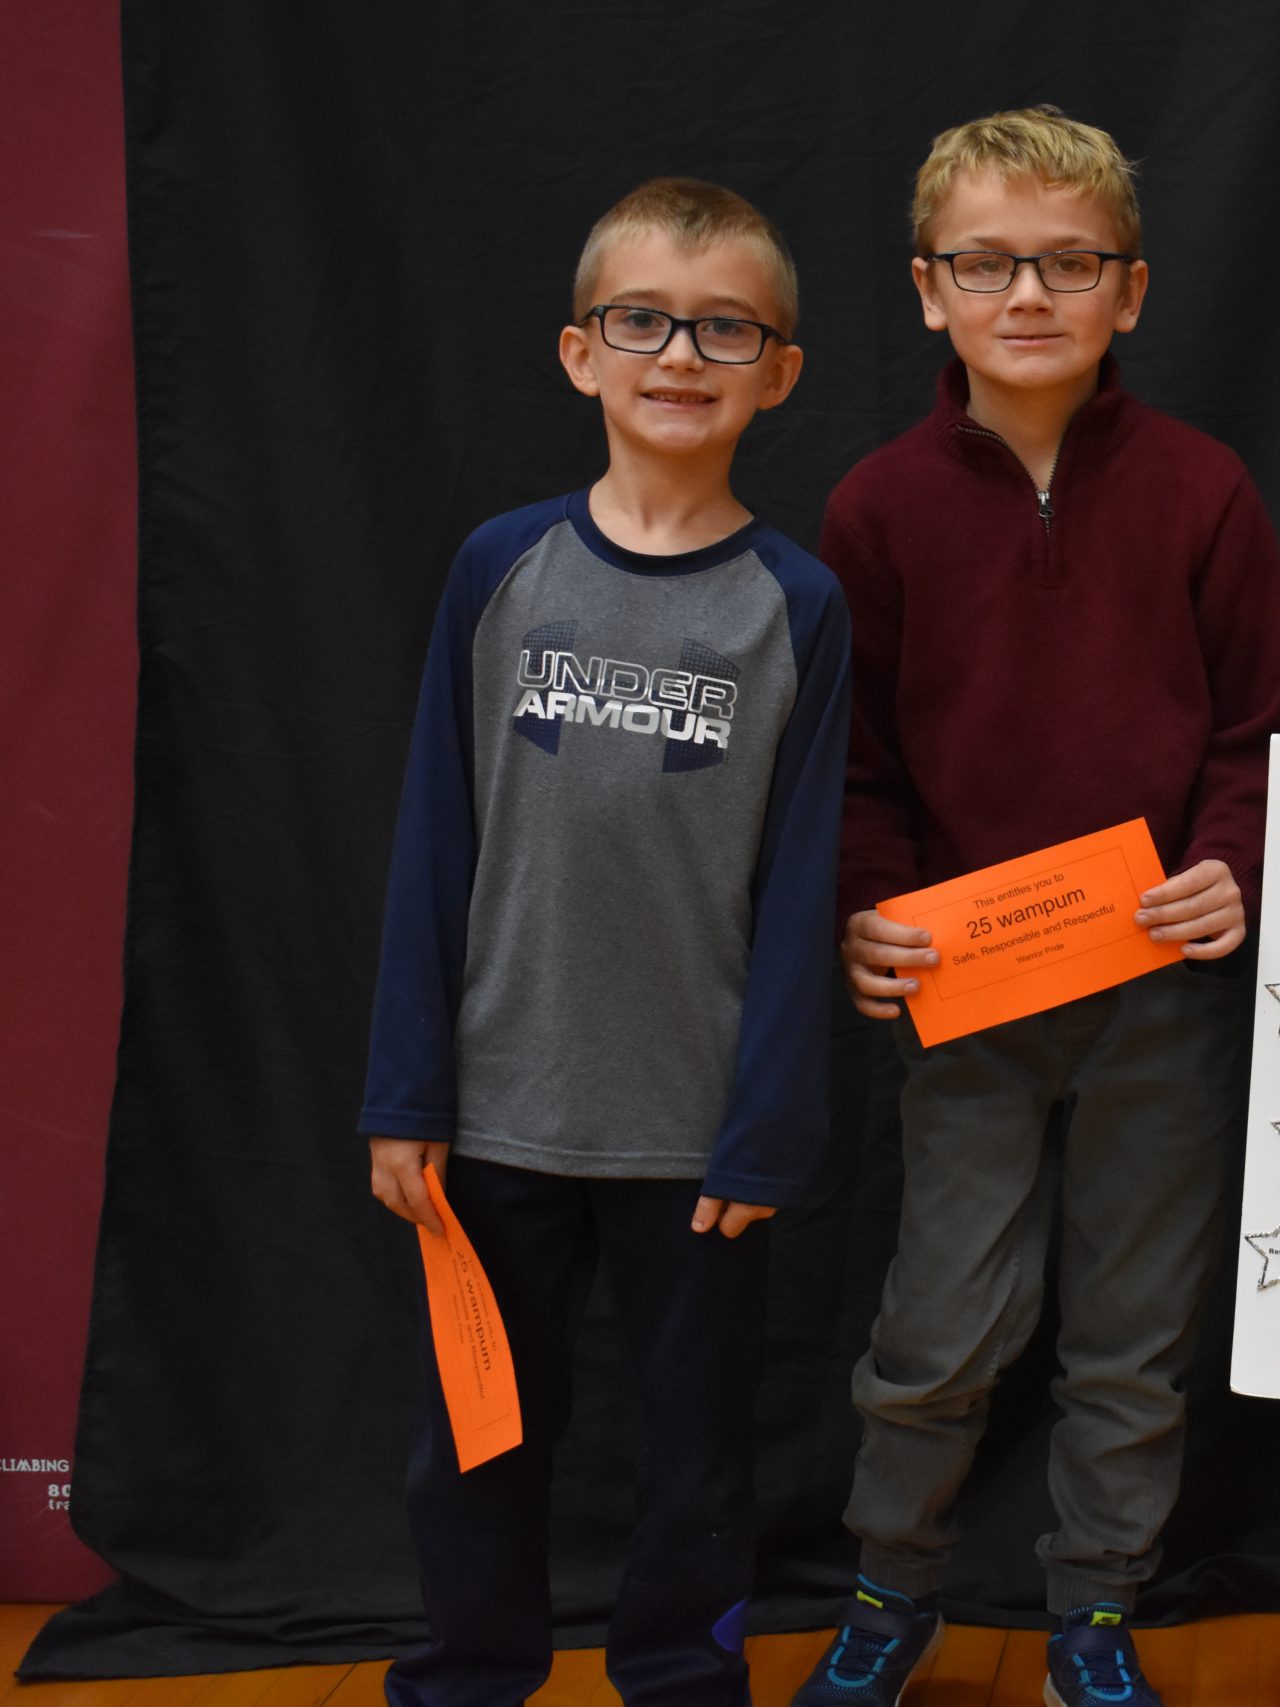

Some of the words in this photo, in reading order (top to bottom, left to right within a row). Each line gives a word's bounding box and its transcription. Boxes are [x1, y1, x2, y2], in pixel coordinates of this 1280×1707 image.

[517, 650, 737, 719] UNDER
[513, 690, 731, 749] ARMOUR
[966, 916, 993, 939] 25
[996, 888, 1086, 929] wampum
[973, 896, 995, 909] This
[997, 885, 1032, 903] entitles
[1033, 877, 1053, 892] you
[1053, 872, 1065, 882] to
[952, 951, 980, 966] Safe,
[980, 930, 1041, 957] Responsible
[1043, 921, 1062, 936] and
[1063, 903, 1116, 930] Respectful
[1016, 950, 1044, 964] Warrior
[1044, 943, 1065, 955] Pride
[466, 1278, 492, 1372] wampum
[0, 1459, 70, 1472] LIMBING
